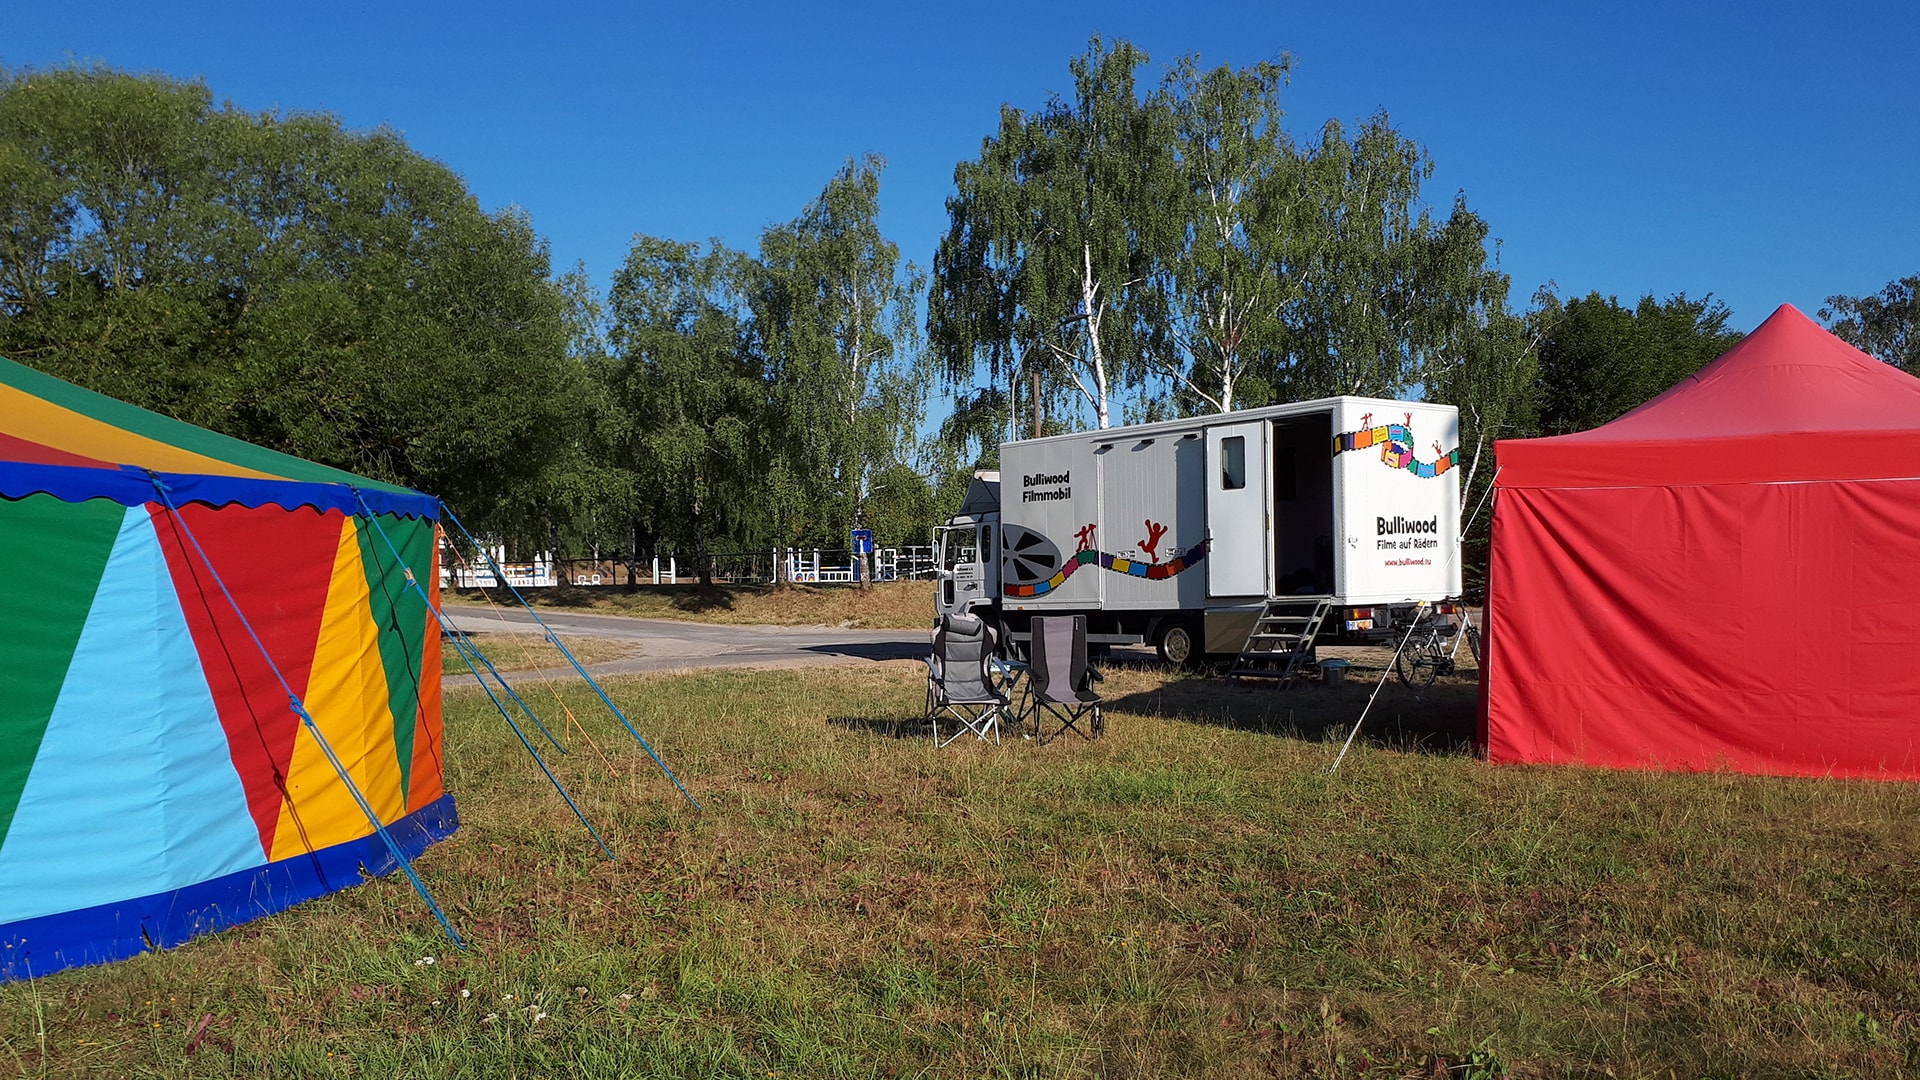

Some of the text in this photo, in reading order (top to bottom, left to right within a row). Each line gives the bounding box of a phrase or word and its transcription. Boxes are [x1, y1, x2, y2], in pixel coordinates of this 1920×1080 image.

[1023, 470, 1070, 488] Bulliwood
[1022, 487, 1071, 503] Filmmobil
[1377, 515, 1437, 536] Bulliwood
[1377, 537, 1438, 550] Filme auf Rädern
